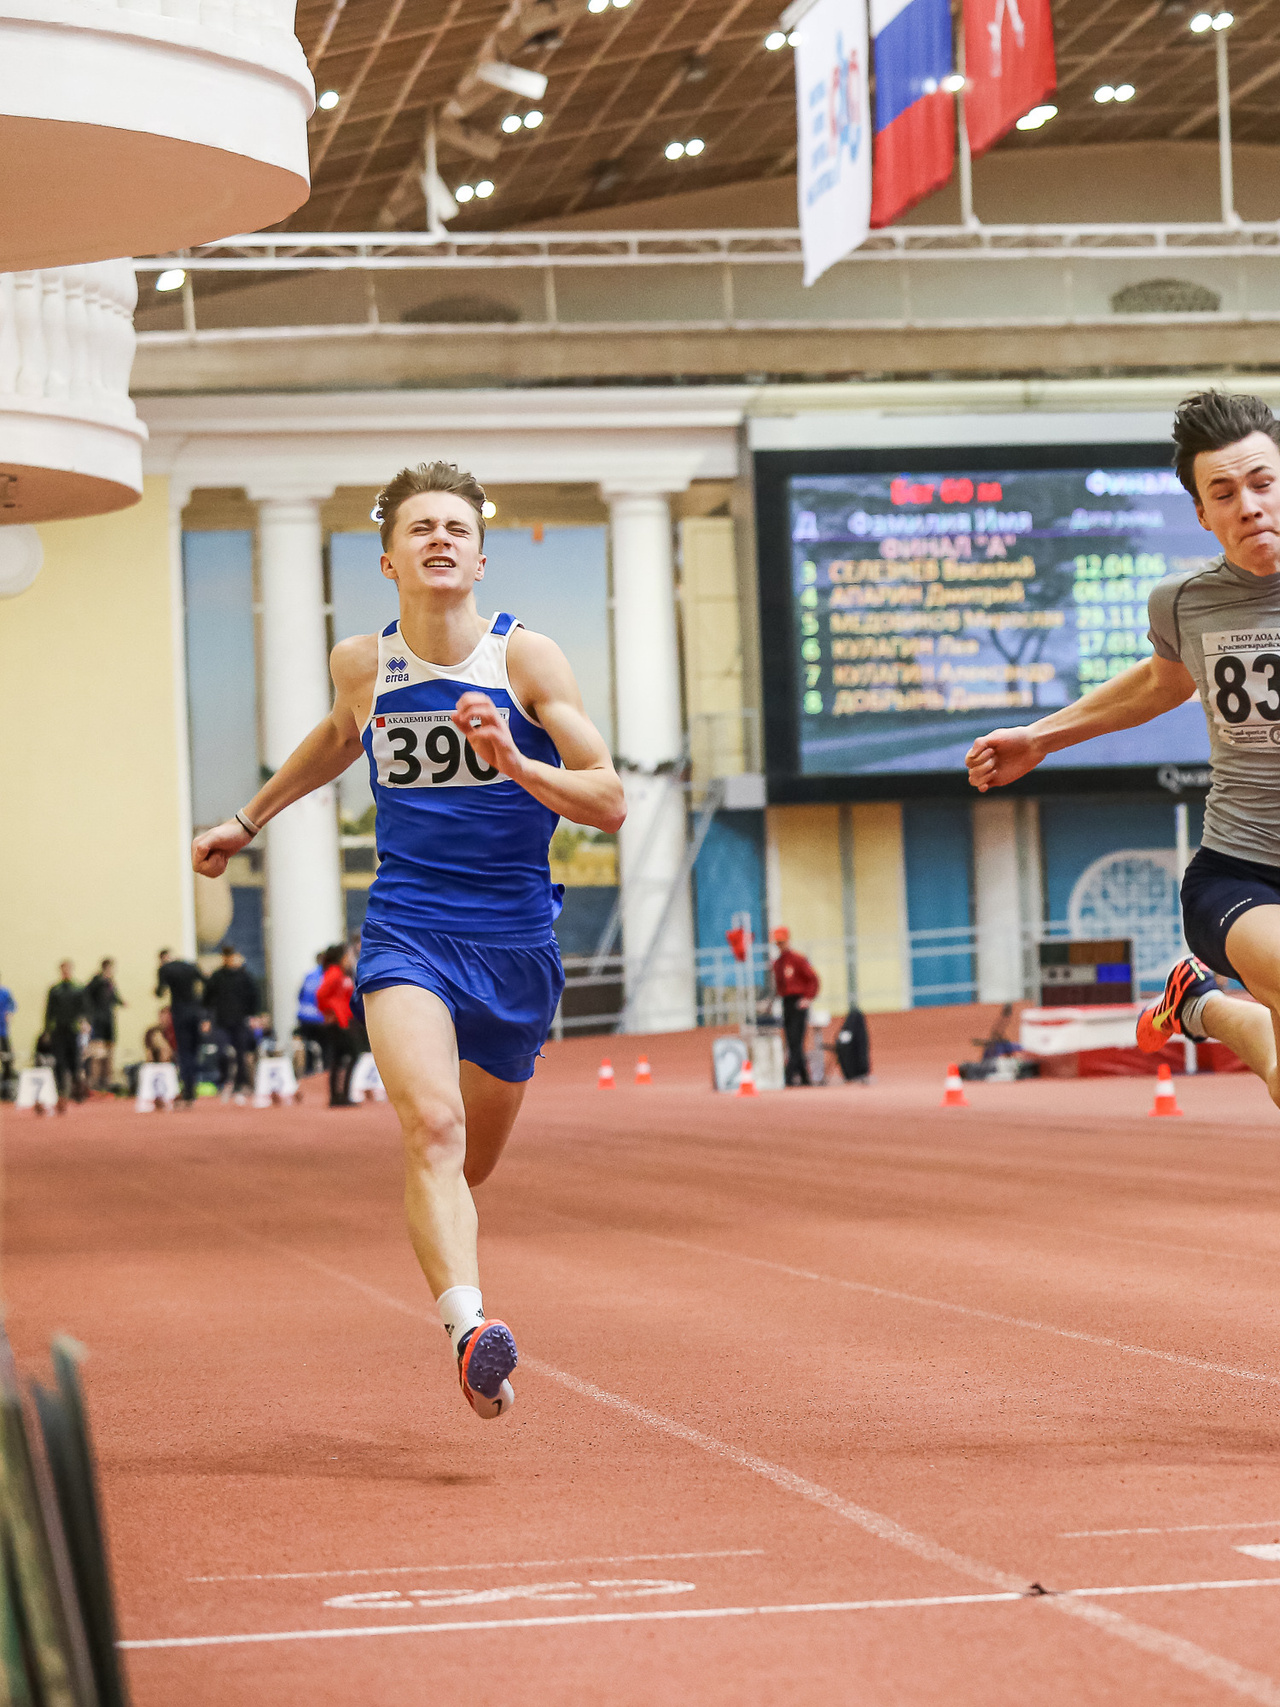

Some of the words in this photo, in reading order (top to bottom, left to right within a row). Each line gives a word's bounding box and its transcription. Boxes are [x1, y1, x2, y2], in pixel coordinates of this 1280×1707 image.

[848, 512, 971, 536] Фамилия
[975, 510, 1032, 532] Имя
[880, 536, 971, 559] ФИНАЛ
[801, 561, 817, 584] 3
[801, 585, 818, 607] 4
[801, 613, 818, 636] 5
[1231, 633, 1253, 642] ГБОУ
[1254, 633, 1273, 642] ДОД
[801, 638, 821, 661] 6
[385, 673, 409, 683] errea
[805, 665, 821, 687] 7
[804, 690, 822, 714] 8
[387, 716, 432, 725] АКАДЕМИЯ
[387, 726, 499, 784] 390
